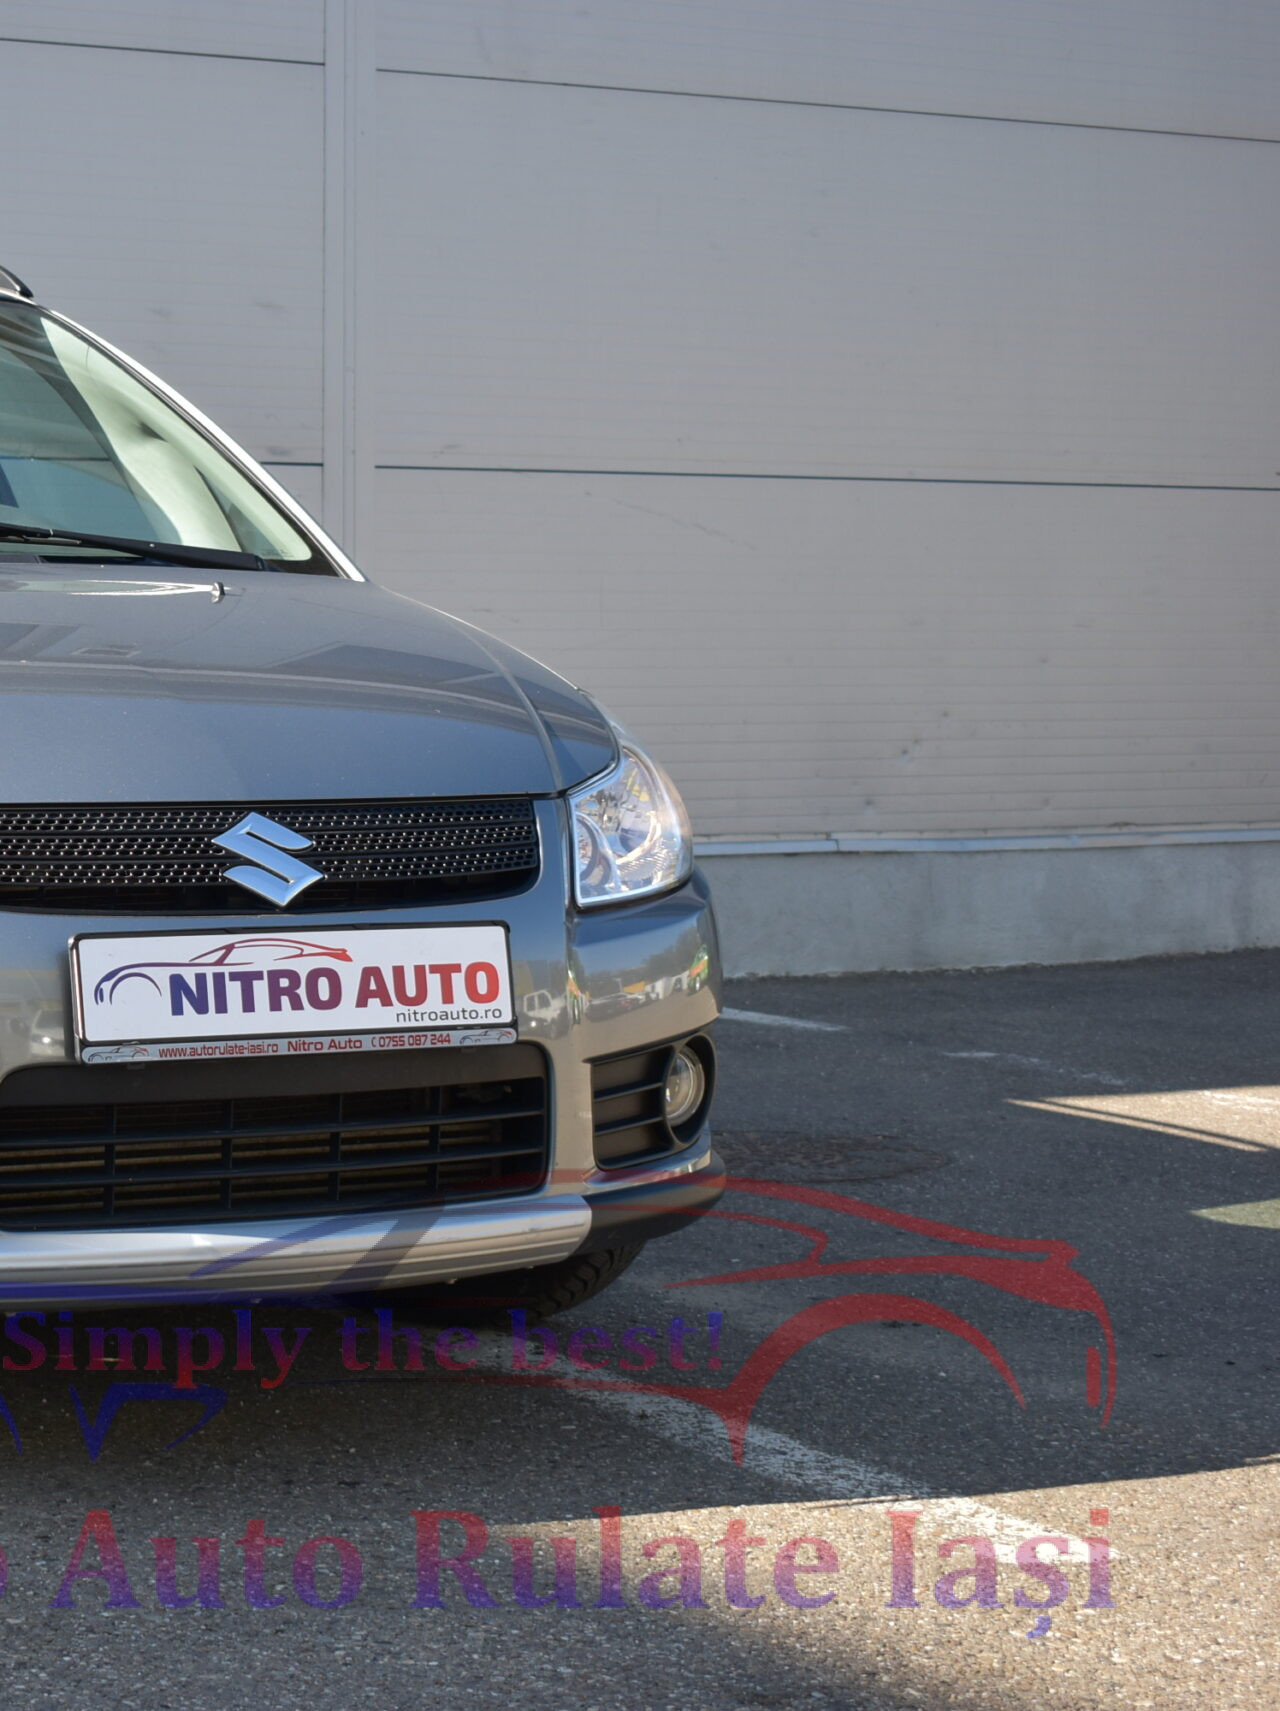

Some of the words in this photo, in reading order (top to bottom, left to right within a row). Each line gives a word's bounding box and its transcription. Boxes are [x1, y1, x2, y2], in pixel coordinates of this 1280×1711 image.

[168, 967, 342, 1016] NITRO
[355, 961, 500, 1008] AUTO
[395, 1007, 502, 1023] nitroauto.ro
[158, 1041, 279, 1058] www.autorulate-iasi.ro
[287, 1039, 324, 1052] Nitro
[327, 1038, 363, 1050] Auto
[378, 1035, 406, 1048] 0755
[407, 1034, 428, 1046] 087
[430, 1032, 452, 1045] 244
